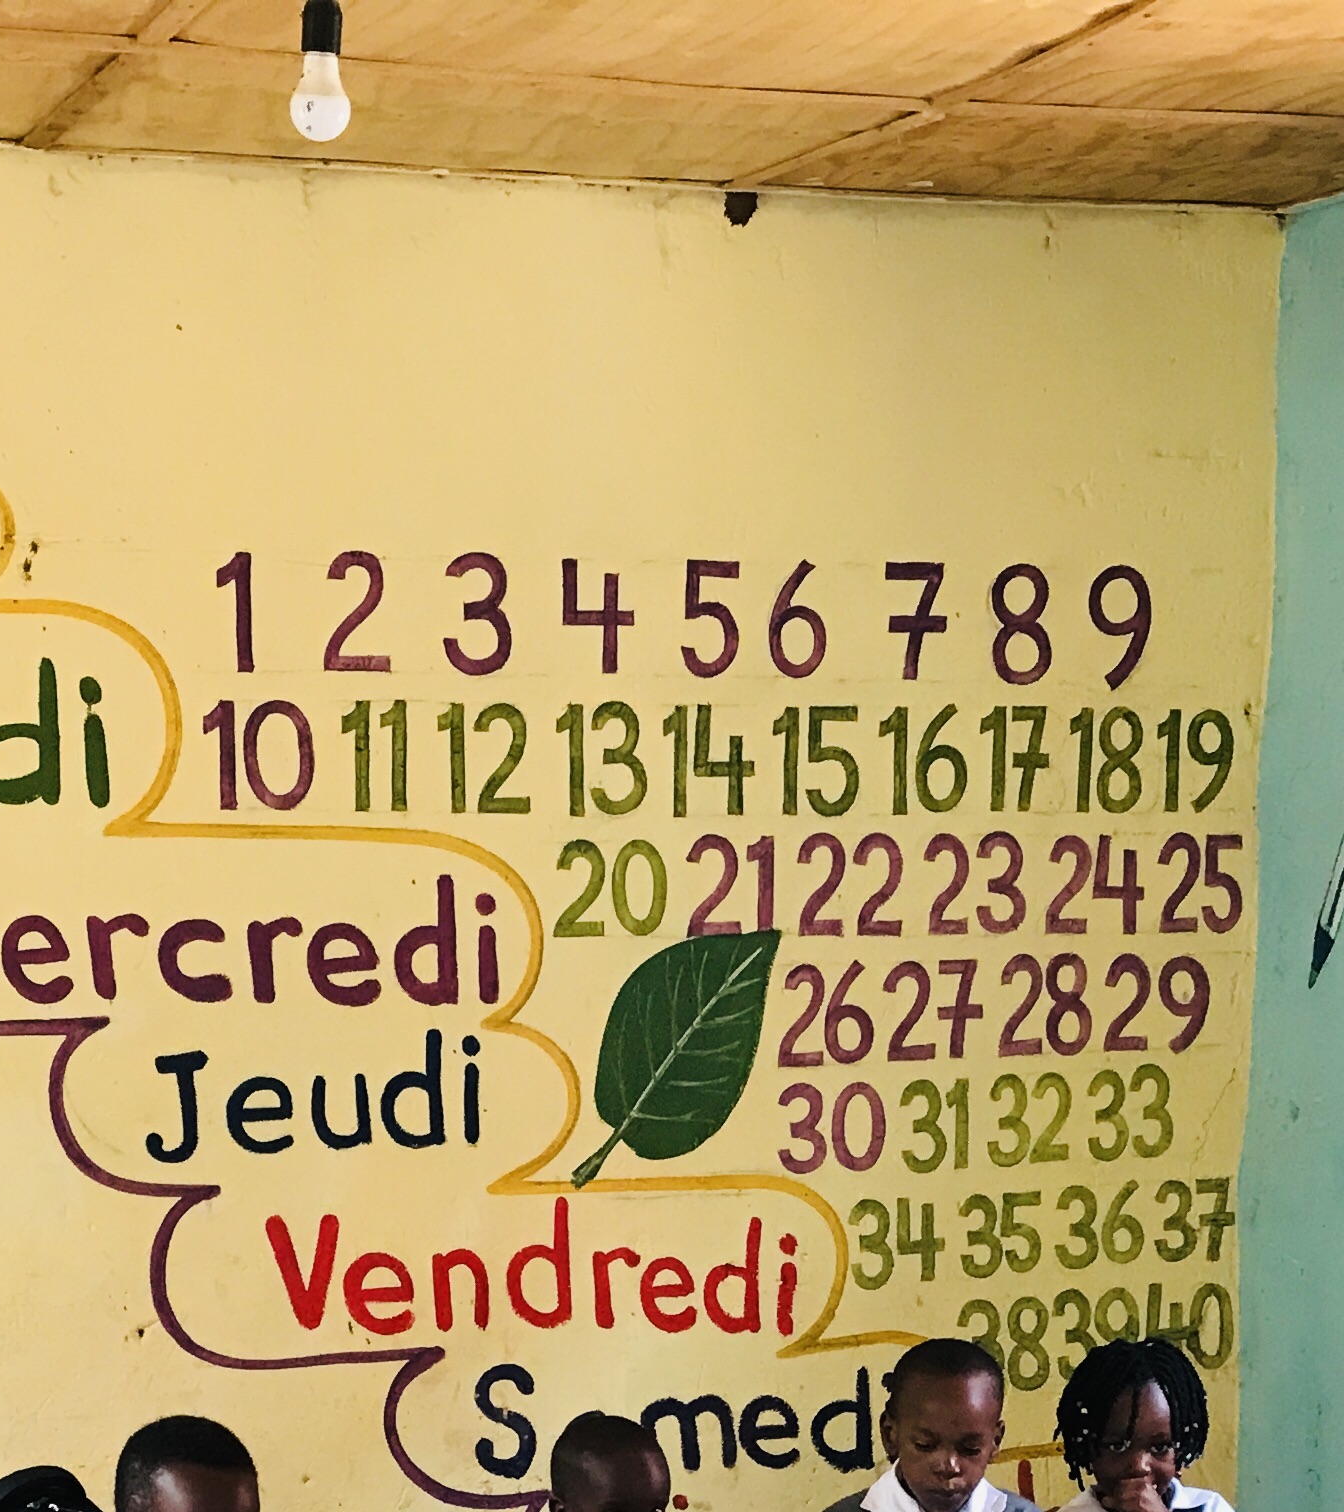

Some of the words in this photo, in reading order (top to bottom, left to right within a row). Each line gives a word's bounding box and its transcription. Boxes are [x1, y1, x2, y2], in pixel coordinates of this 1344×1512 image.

[215, 551, 256, 674] 1
[322, 549, 393, 675] 2
[442, 551, 513, 677] 3
[560, 557, 636, 675] 4
[680, 558, 741, 680] 5
[768, 558, 828, 680] 6
[884, 561, 948, 681] 7
[990, 562, 1053, 686] 8
[1088, 563, 1152, 692] 9
[202, 699, 316, 812] 10
[340, 698, 409, 813] 11
[436, 701, 532, 815] 12
[555, 700, 648, 818] 13
[662, 701, 756, 819] 14
[771, 705, 860, 819] 15
[878, 702, 968, 817] 16
[979, 705, 1050, 813] 17
[1069, 706, 1144, 814] 18
[1156, 708, 1235, 814] 19
[552, 838, 668, 938] 20
[685, 834, 774, 938] 21
[796, 832, 904, 938] 22
[923, 830, 1027, 936] 23
[1044, 833, 1145, 936] 24
[1157, 831, 1244, 935] 25
[777, 959, 875, 1068] 26
[882, 958, 984, 1063] 27
[997, 952, 1093, 1059] 28
[1103, 952, 1211, 1055] 29
[144, 1028, 482, 1164] Jeudi
[777, 1081, 887, 1175] 30
[899, 1077, 970, 1174] 31
[987, 1071, 1072, 1168] 32
[1086, 1063, 1174, 1162] 33
[264, 1195, 798, 1337] Vendredi
[849, 1197, 946, 1291] 34
[958, 1190, 1043, 1279] 35
[1054, 1179, 1145, 1270] 36
[1154, 1176, 1236, 1263] 37
[956, 1298, 1051, 1392] 38
[474, 1363, 894, 1481] Smed
